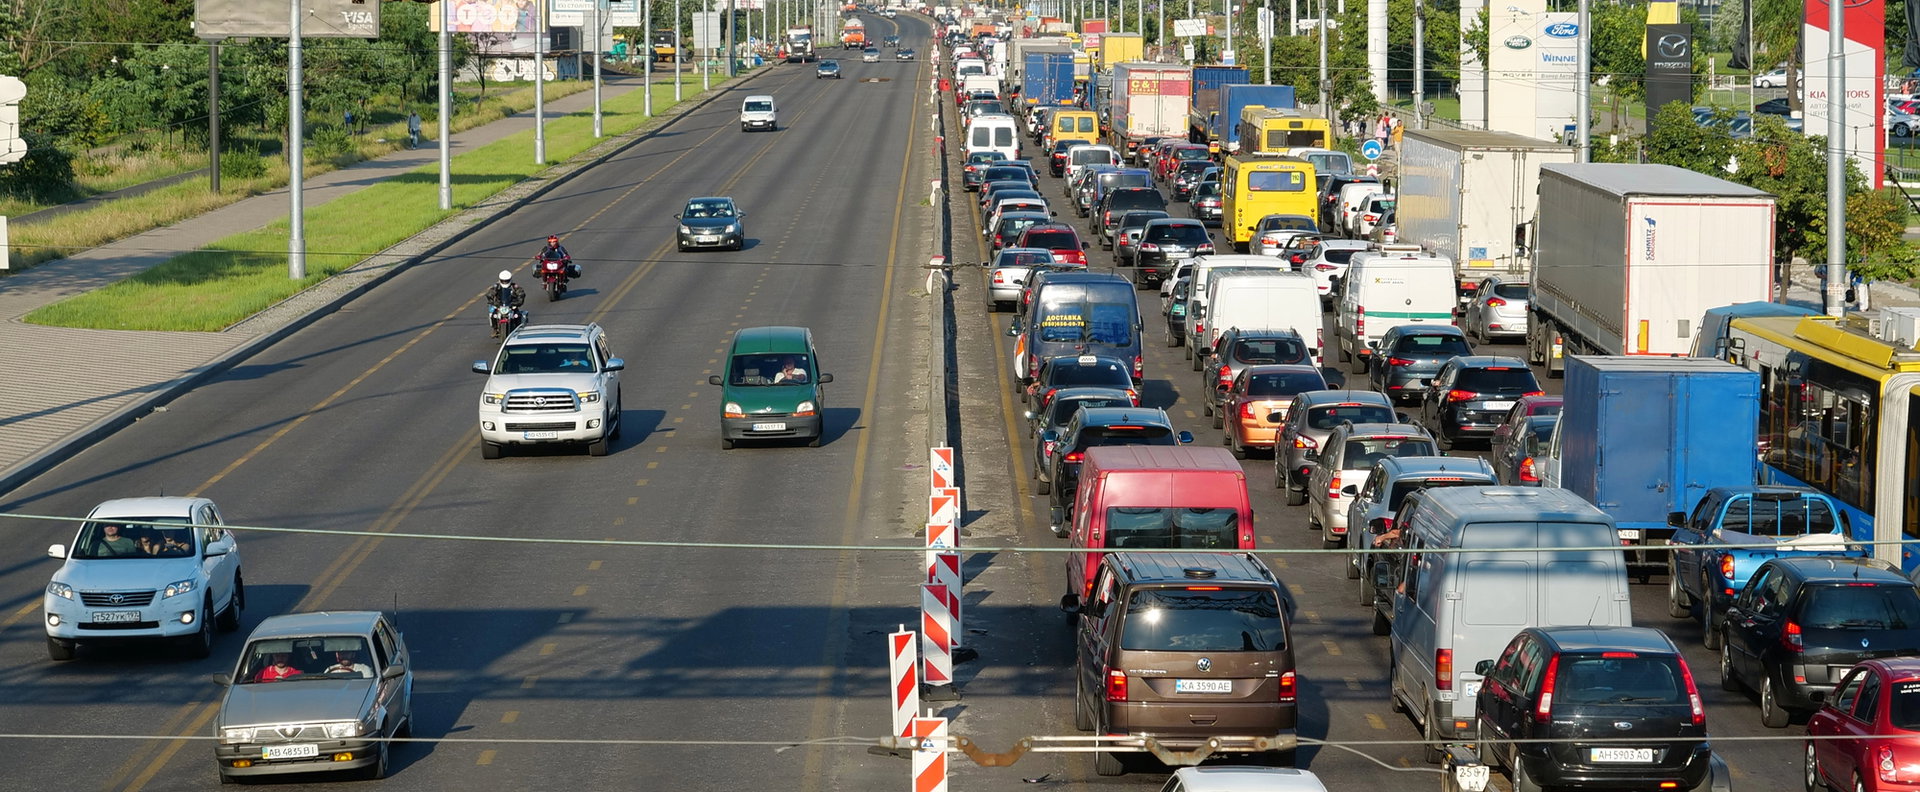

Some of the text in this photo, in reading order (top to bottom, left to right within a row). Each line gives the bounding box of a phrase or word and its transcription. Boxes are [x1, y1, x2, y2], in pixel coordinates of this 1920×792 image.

[341, 11, 373, 23] VISA
[1551, 25, 1576, 35] Ford
[1542, 53, 1576, 62] WINNE
[1182, 680, 1231, 691] KA 3590 AE
[269, 748, 281, 757] AB
[283, 746, 302, 756] 4835
[1598, 750, 1650, 760] AH 5903 AO
